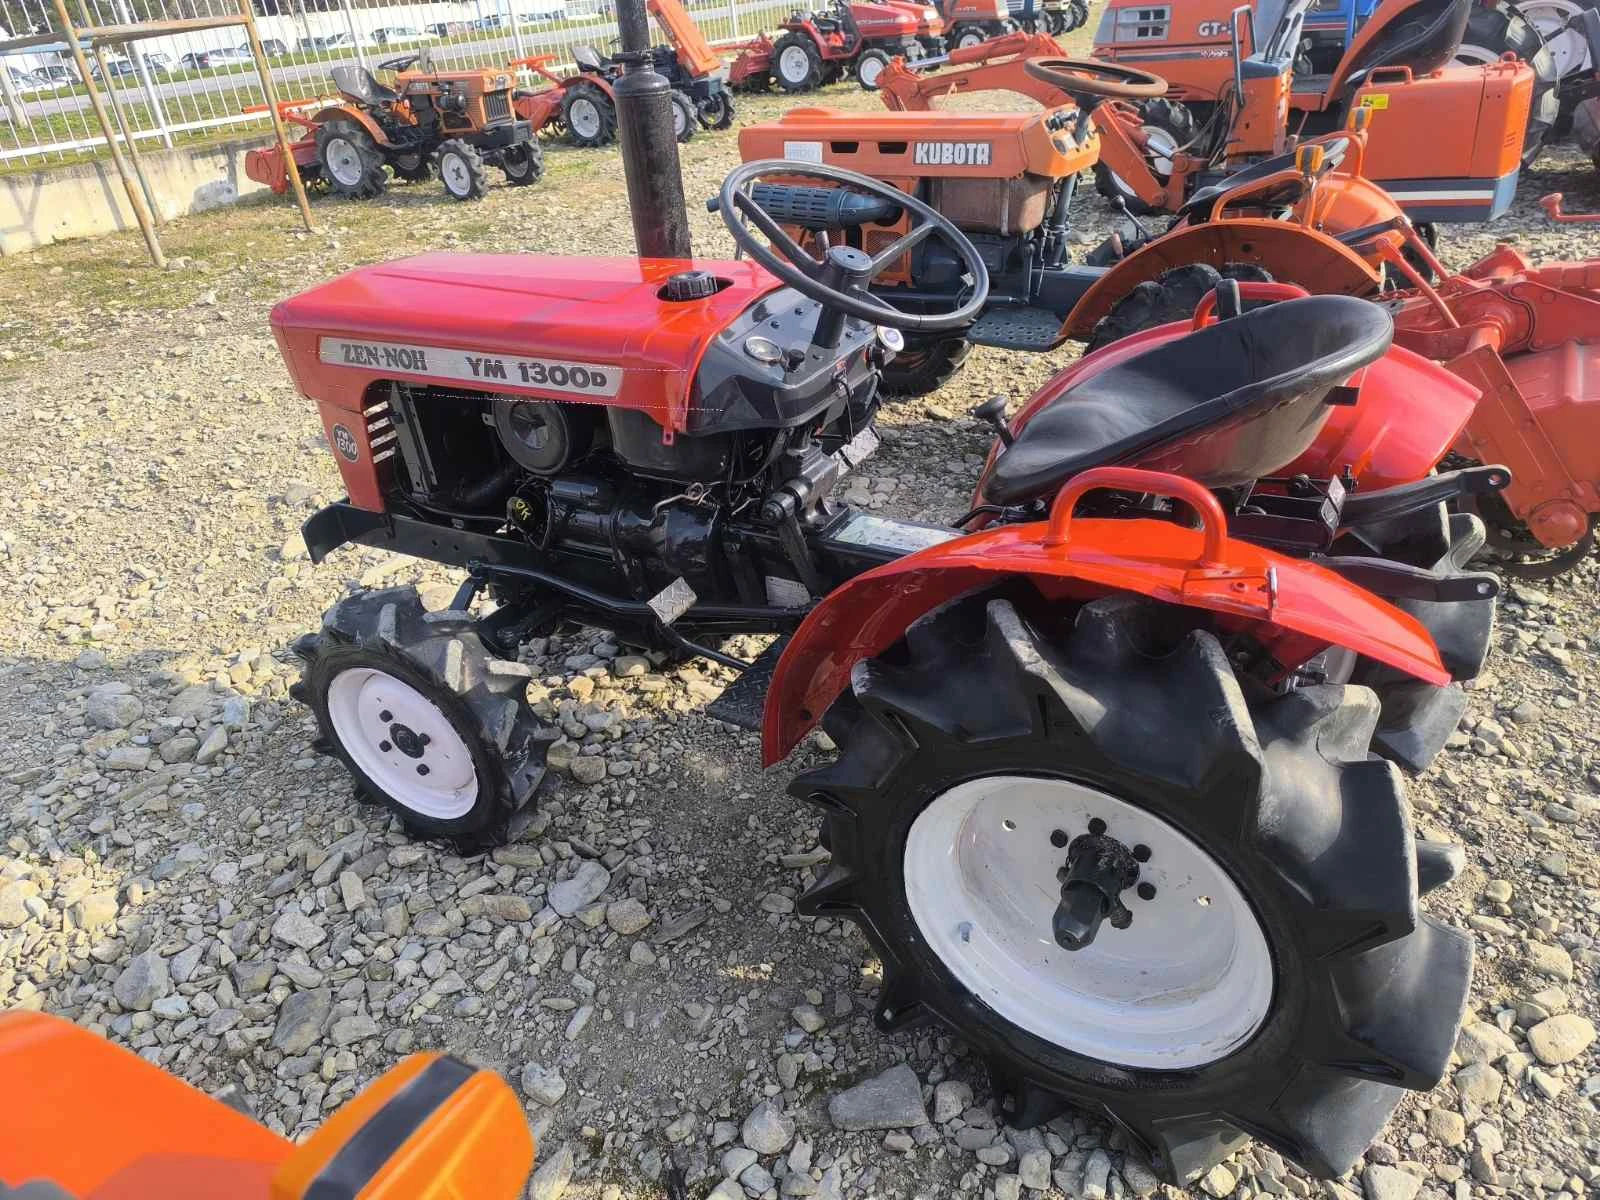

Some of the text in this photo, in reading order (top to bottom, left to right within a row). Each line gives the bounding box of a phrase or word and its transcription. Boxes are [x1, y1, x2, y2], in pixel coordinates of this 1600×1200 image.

[915, 142, 991, 165] KUBOTA
[340, 343, 428, 371] ZEN-NOH
[465, 356, 508, 379] YM
[336, 437, 357, 455] 1300
